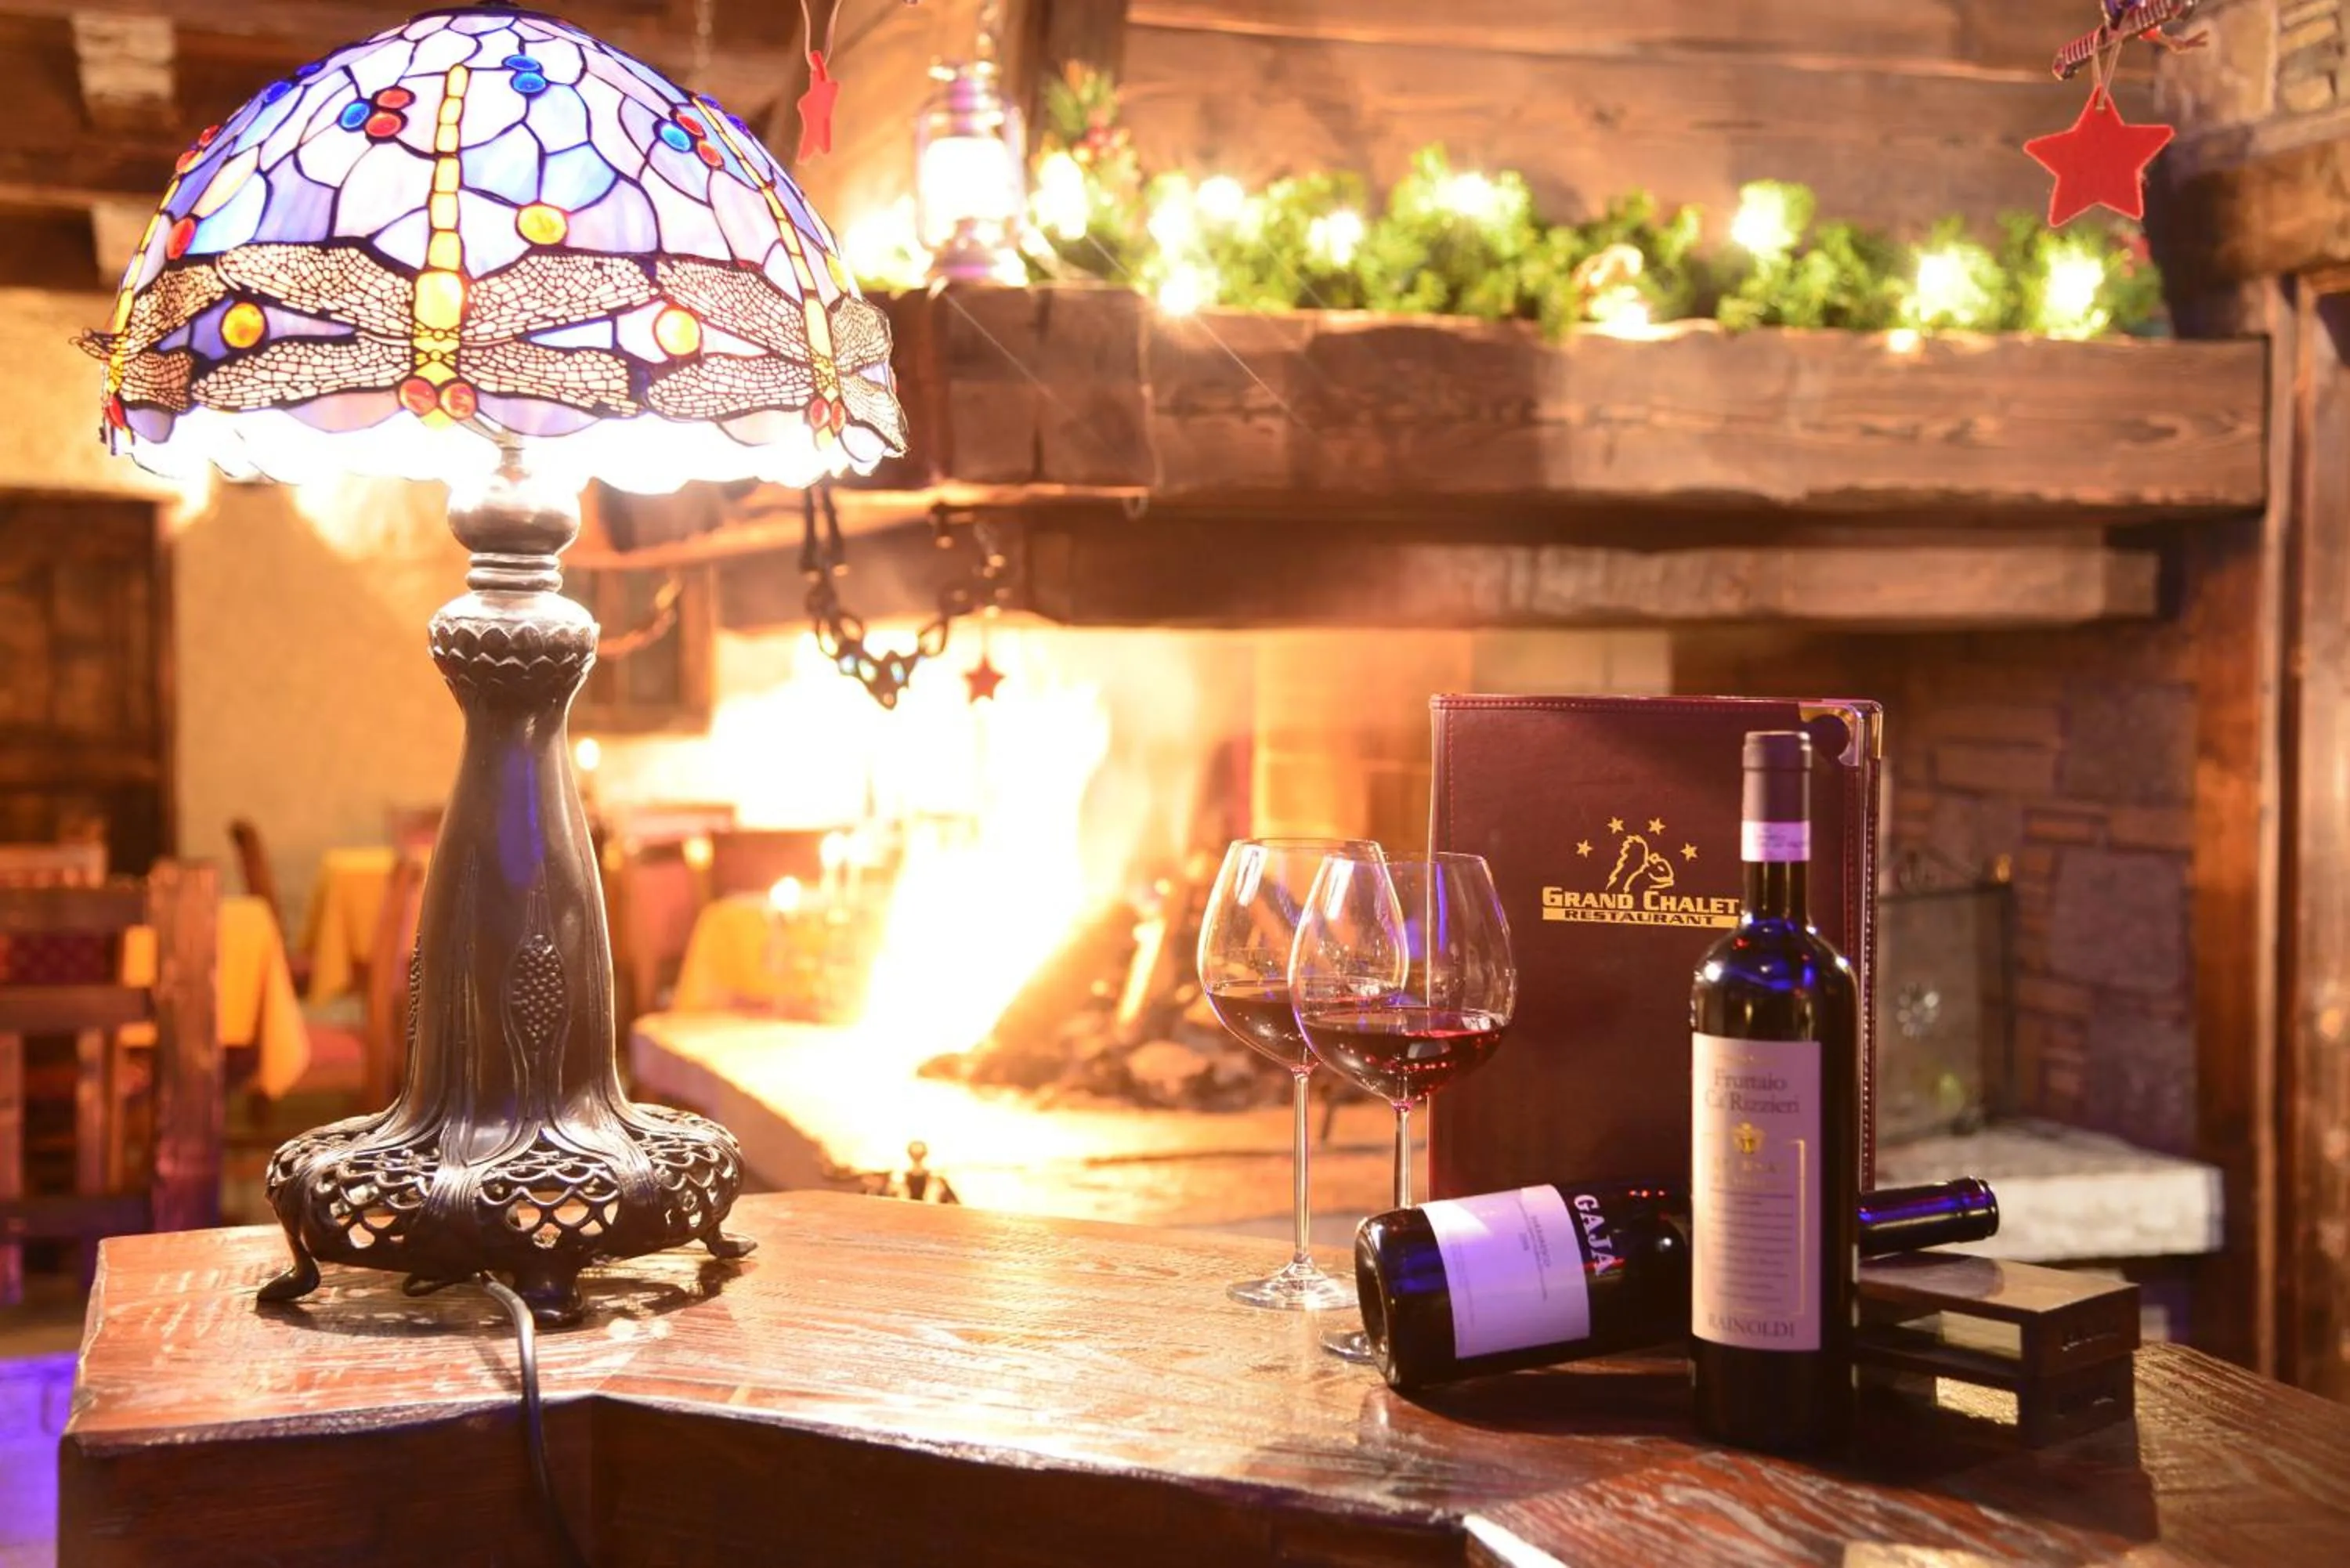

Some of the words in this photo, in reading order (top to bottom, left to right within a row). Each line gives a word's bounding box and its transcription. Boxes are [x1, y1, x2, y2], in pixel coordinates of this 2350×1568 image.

[1542, 887, 1633, 910] GRAND
[1643, 891, 1739, 915] CHALET
[1564, 909, 1715, 926] RESTAURANT
[1573, 1194, 1615, 1277] GAJA
